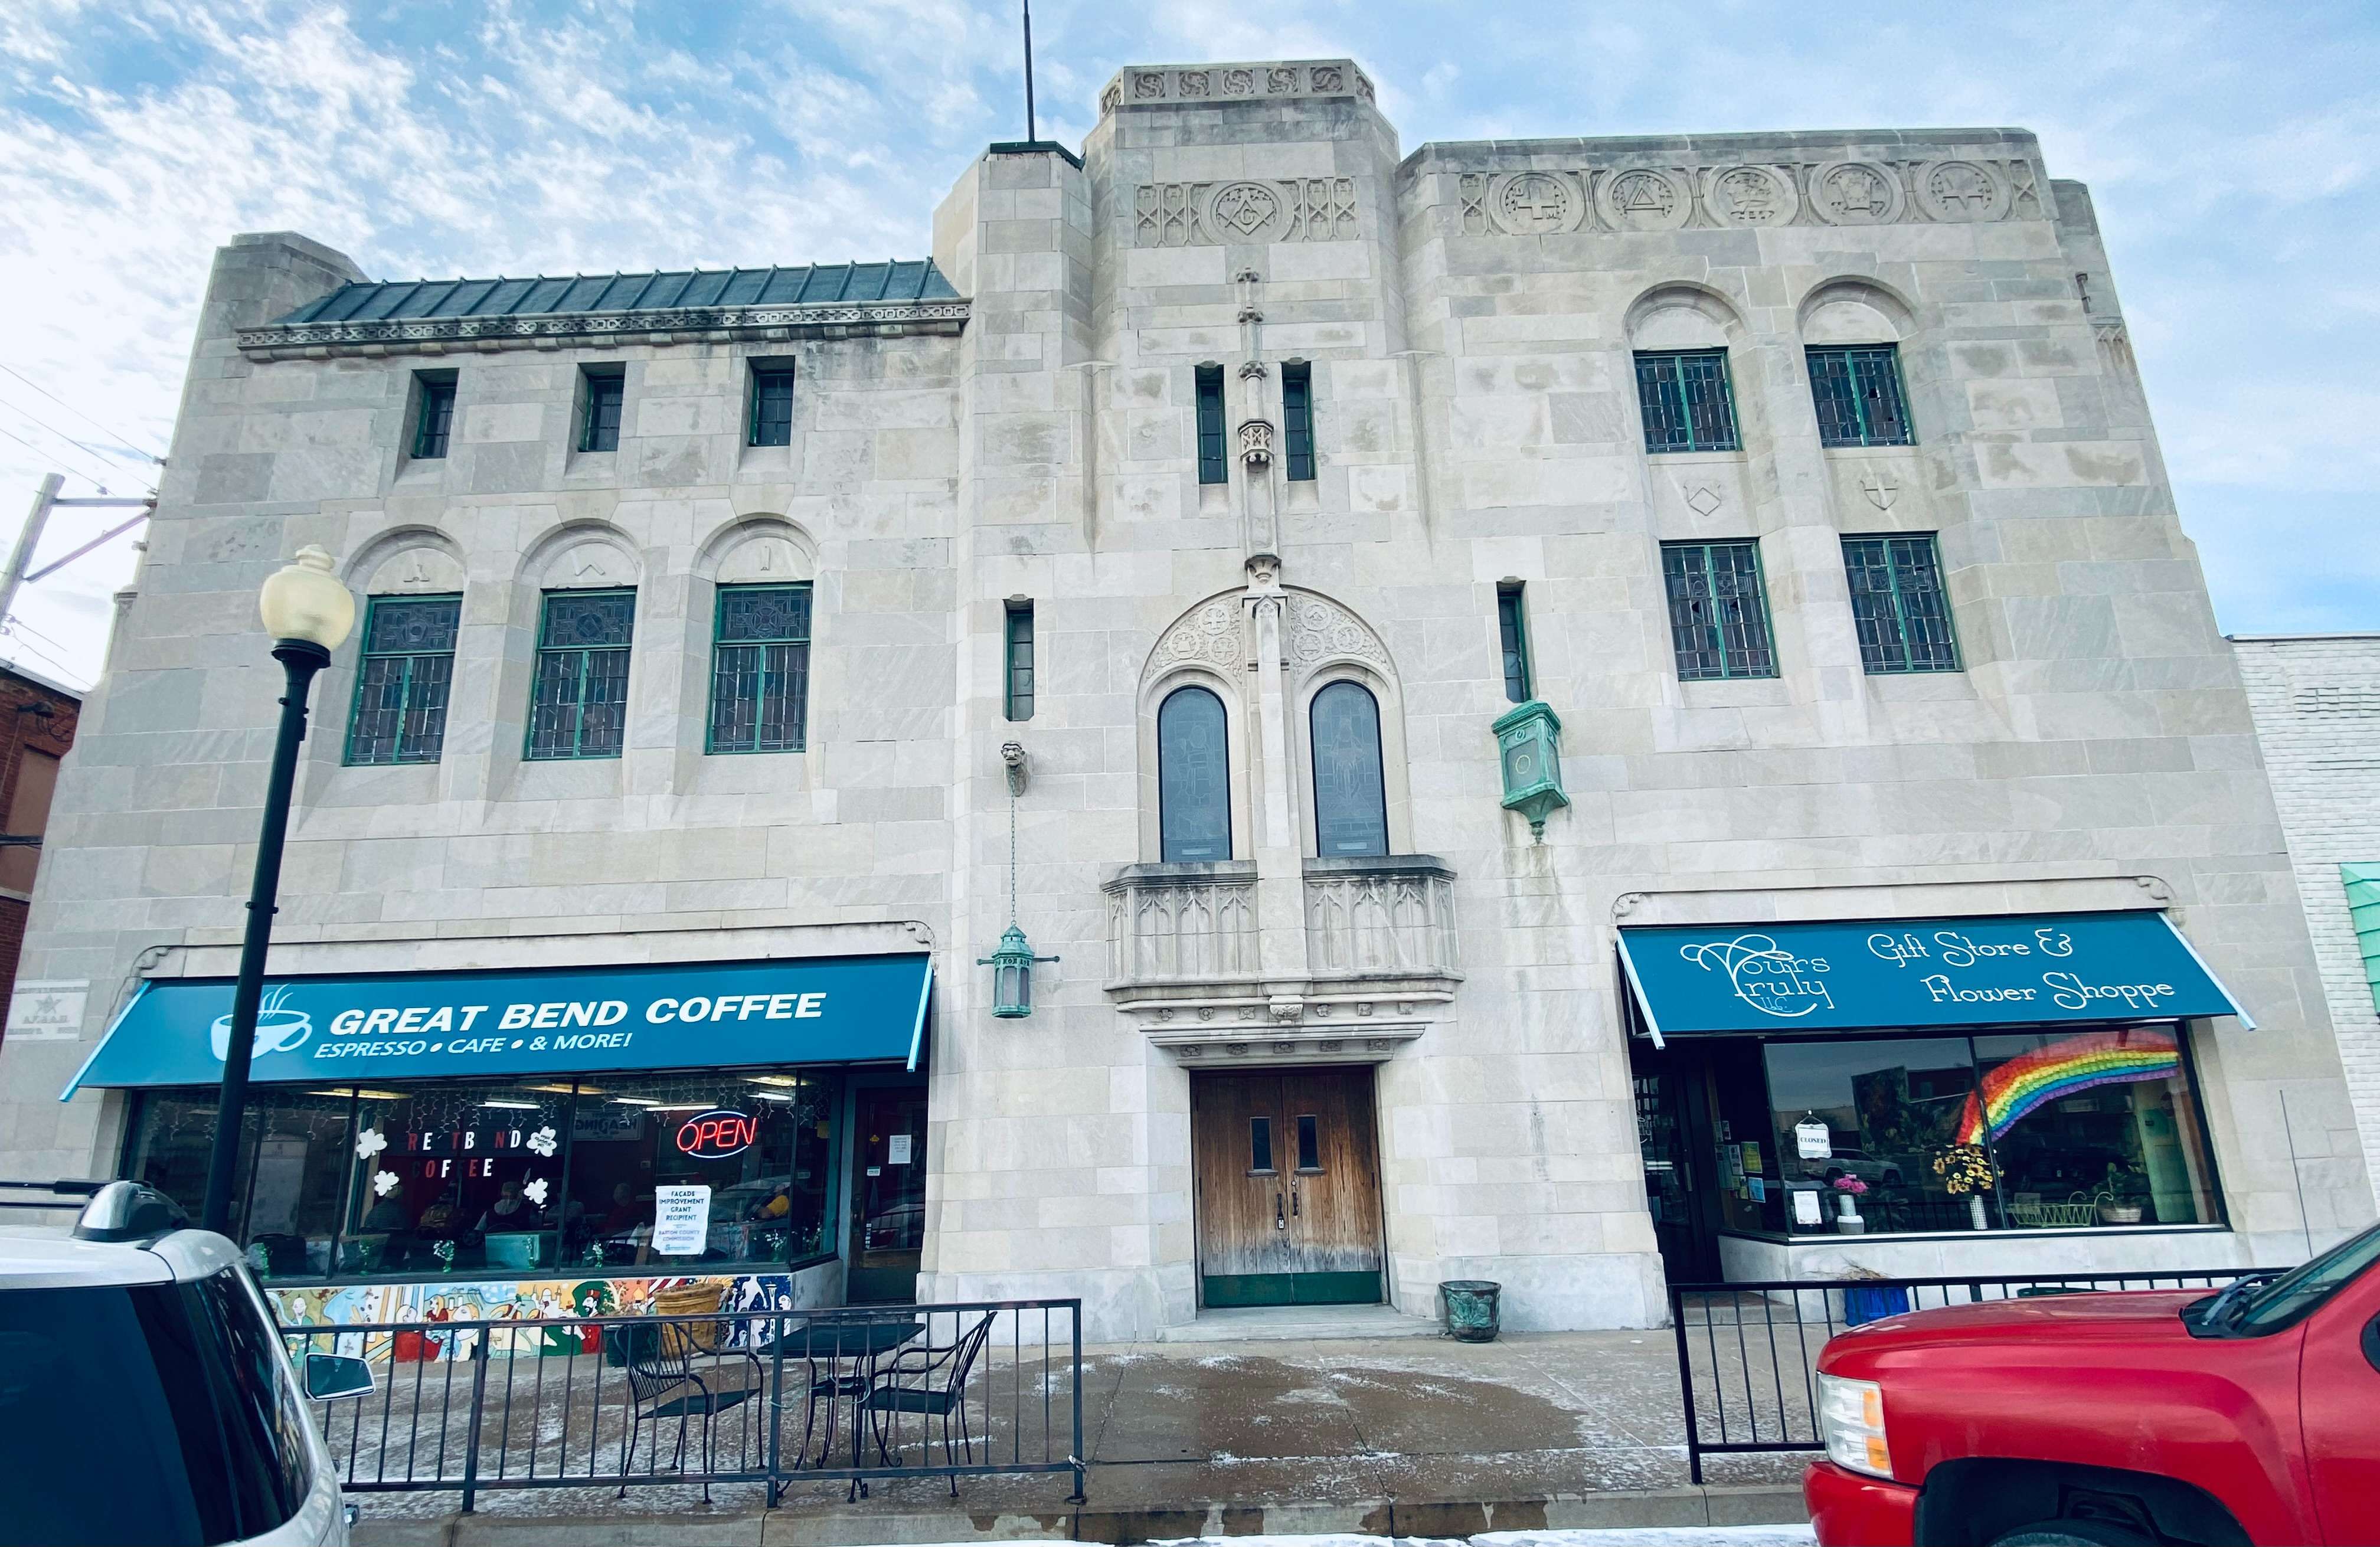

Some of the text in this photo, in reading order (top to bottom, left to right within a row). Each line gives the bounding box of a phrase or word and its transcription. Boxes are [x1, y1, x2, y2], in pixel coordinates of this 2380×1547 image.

[1680, 934, 1830, 996] Yours
[1867, 928, 2073, 967] Gift Store &
[1920, 972, 2175, 1010] Flower Shoppe
[330, 992, 826, 1036] GREAT BEND COFFEE
[314, 1032, 633, 1058] ESPRESSO CAFE & MORE!
[677, 1118, 757, 1151] OPEN
